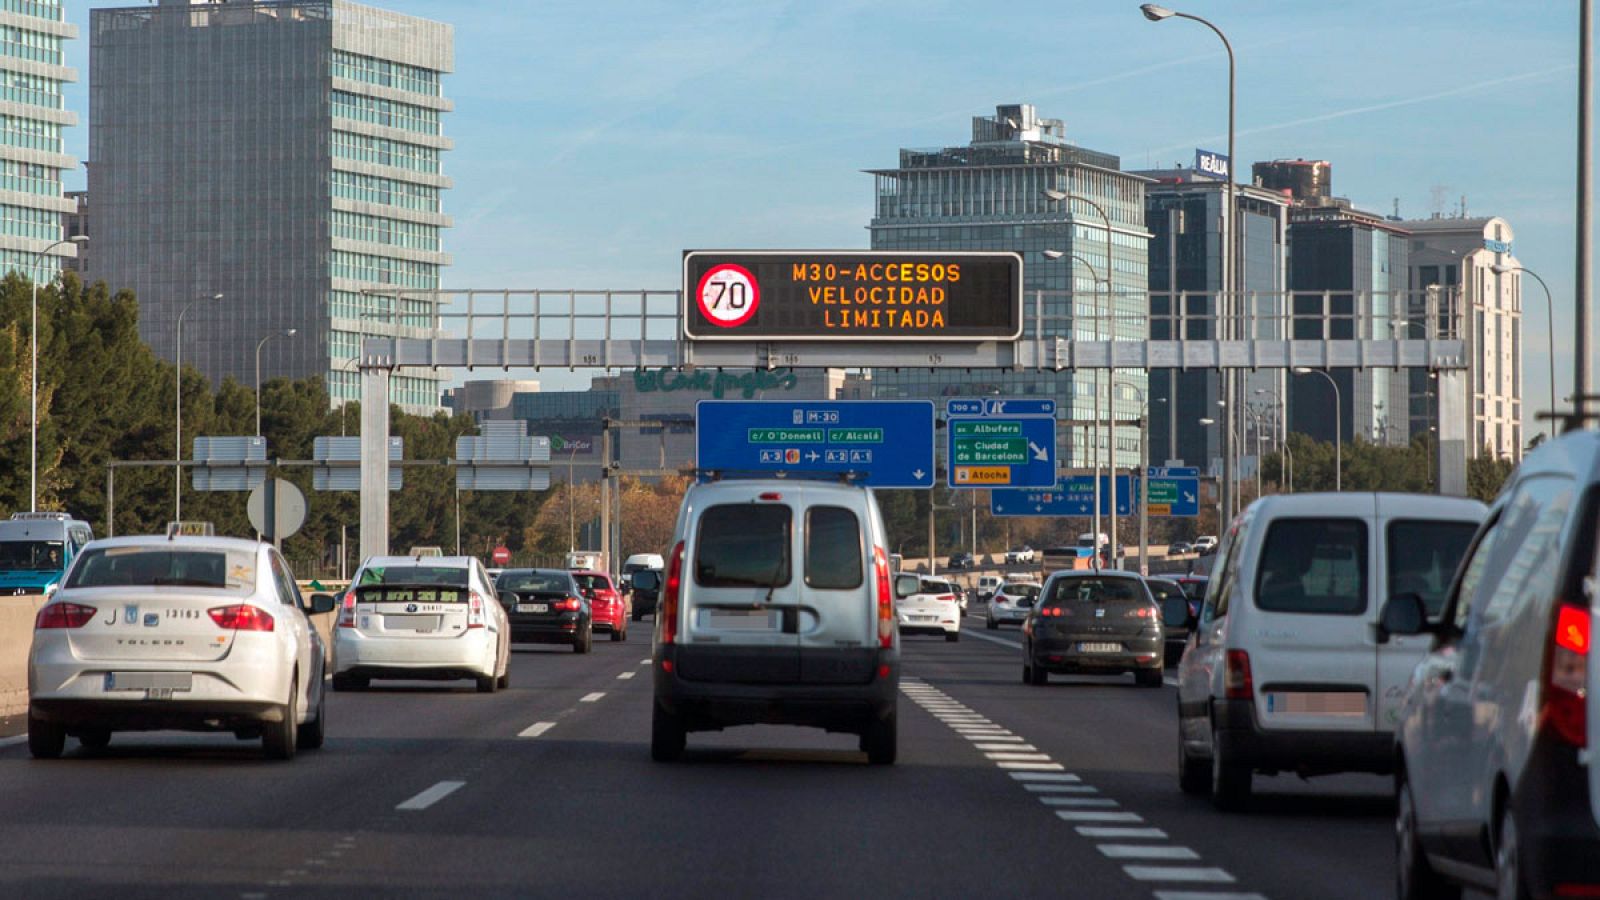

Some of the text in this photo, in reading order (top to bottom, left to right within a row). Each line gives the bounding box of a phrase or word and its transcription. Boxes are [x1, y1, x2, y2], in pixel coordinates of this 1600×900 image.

[792, 263, 961, 282] M30-ACCESOS
[709, 281, 746, 310] 70
[808, 287, 945, 305] VELOCIDAD
[824, 310, 945, 328] LIMITADA
[658, 367, 712, 392] Corte
[1041, 403, 1051, 411] 10
[808, 412, 838, 422] M-30
[974, 424, 1019, 433] Albufera
[768, 431, 821, 440] O'Donnell
[846, 431, 879, 440] Alcalá
[974, 441, 1009, 450] Ciudad
[762, 452, 782, 461] A-3
[827, 452, 846, 461] A-2
[852, 452, 871, 461] A-1
[957, 451, 1025, 460] de Barcelona
[972, 471, 1008, 479] Atocha
